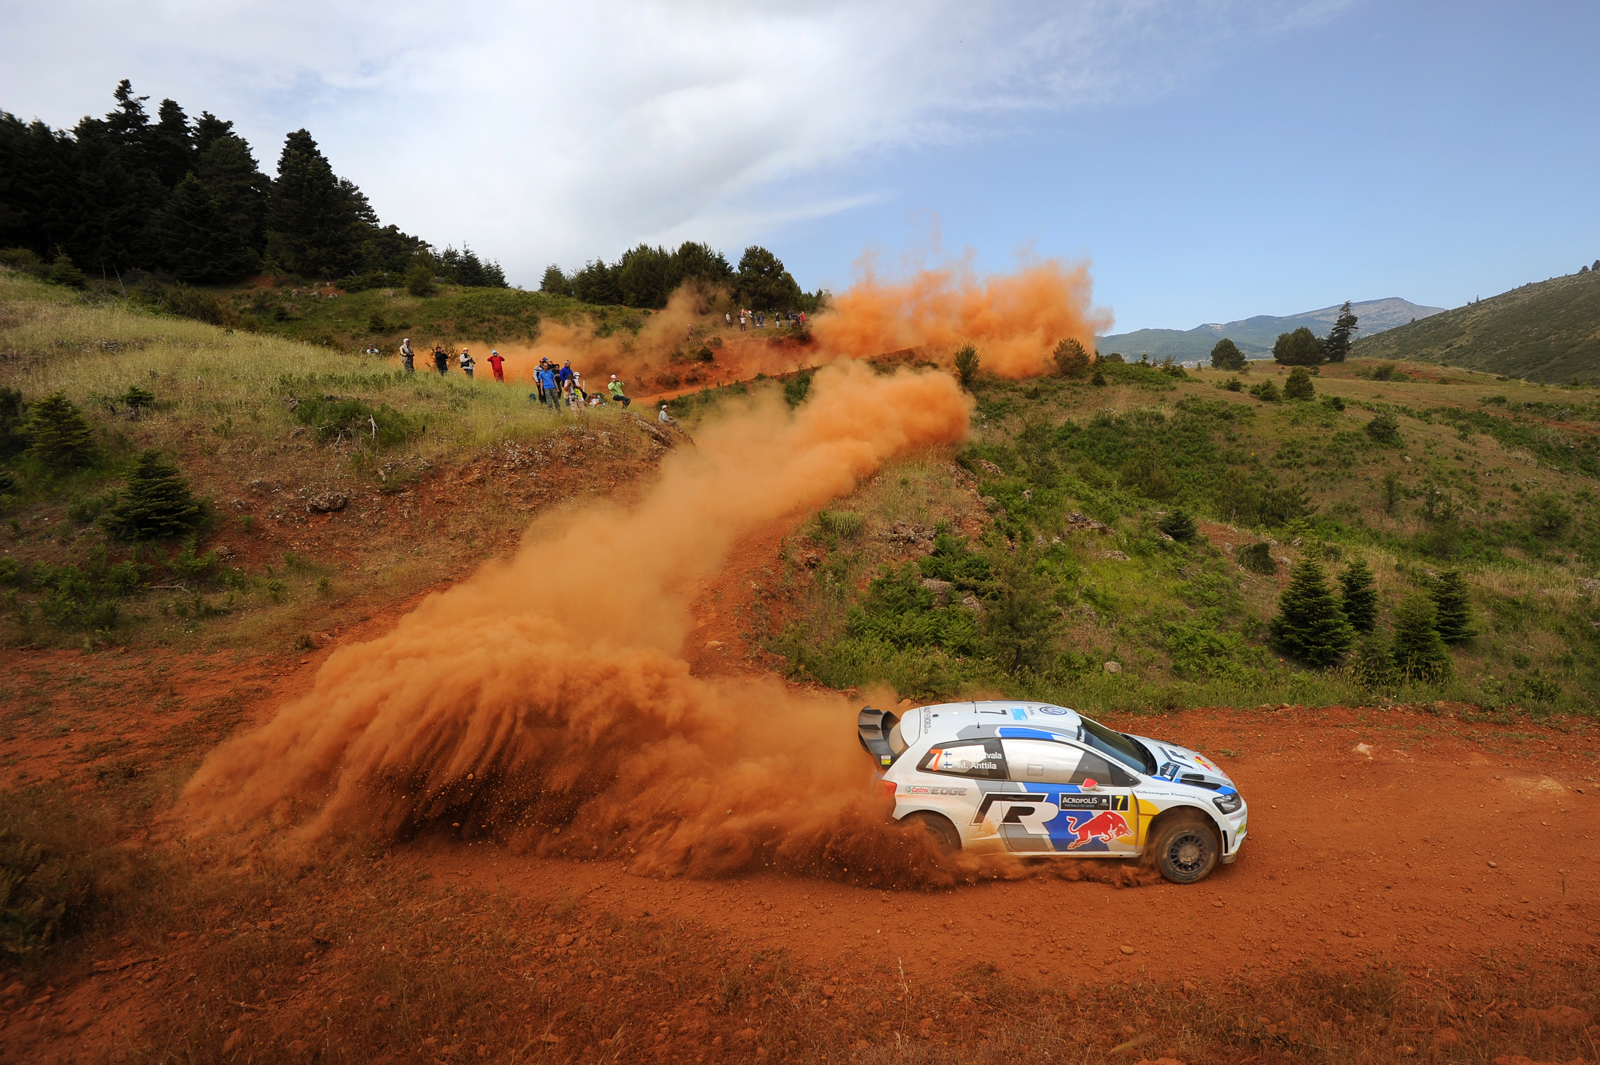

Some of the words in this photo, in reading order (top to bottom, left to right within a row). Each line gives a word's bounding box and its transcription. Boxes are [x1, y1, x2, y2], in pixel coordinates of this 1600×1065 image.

[929, 749, 943, 771] 7
[970, 762, 997, 770] Anttila
[931, 787, 967, 796] EDGE
[1115, 795, 1124, 811] 7
